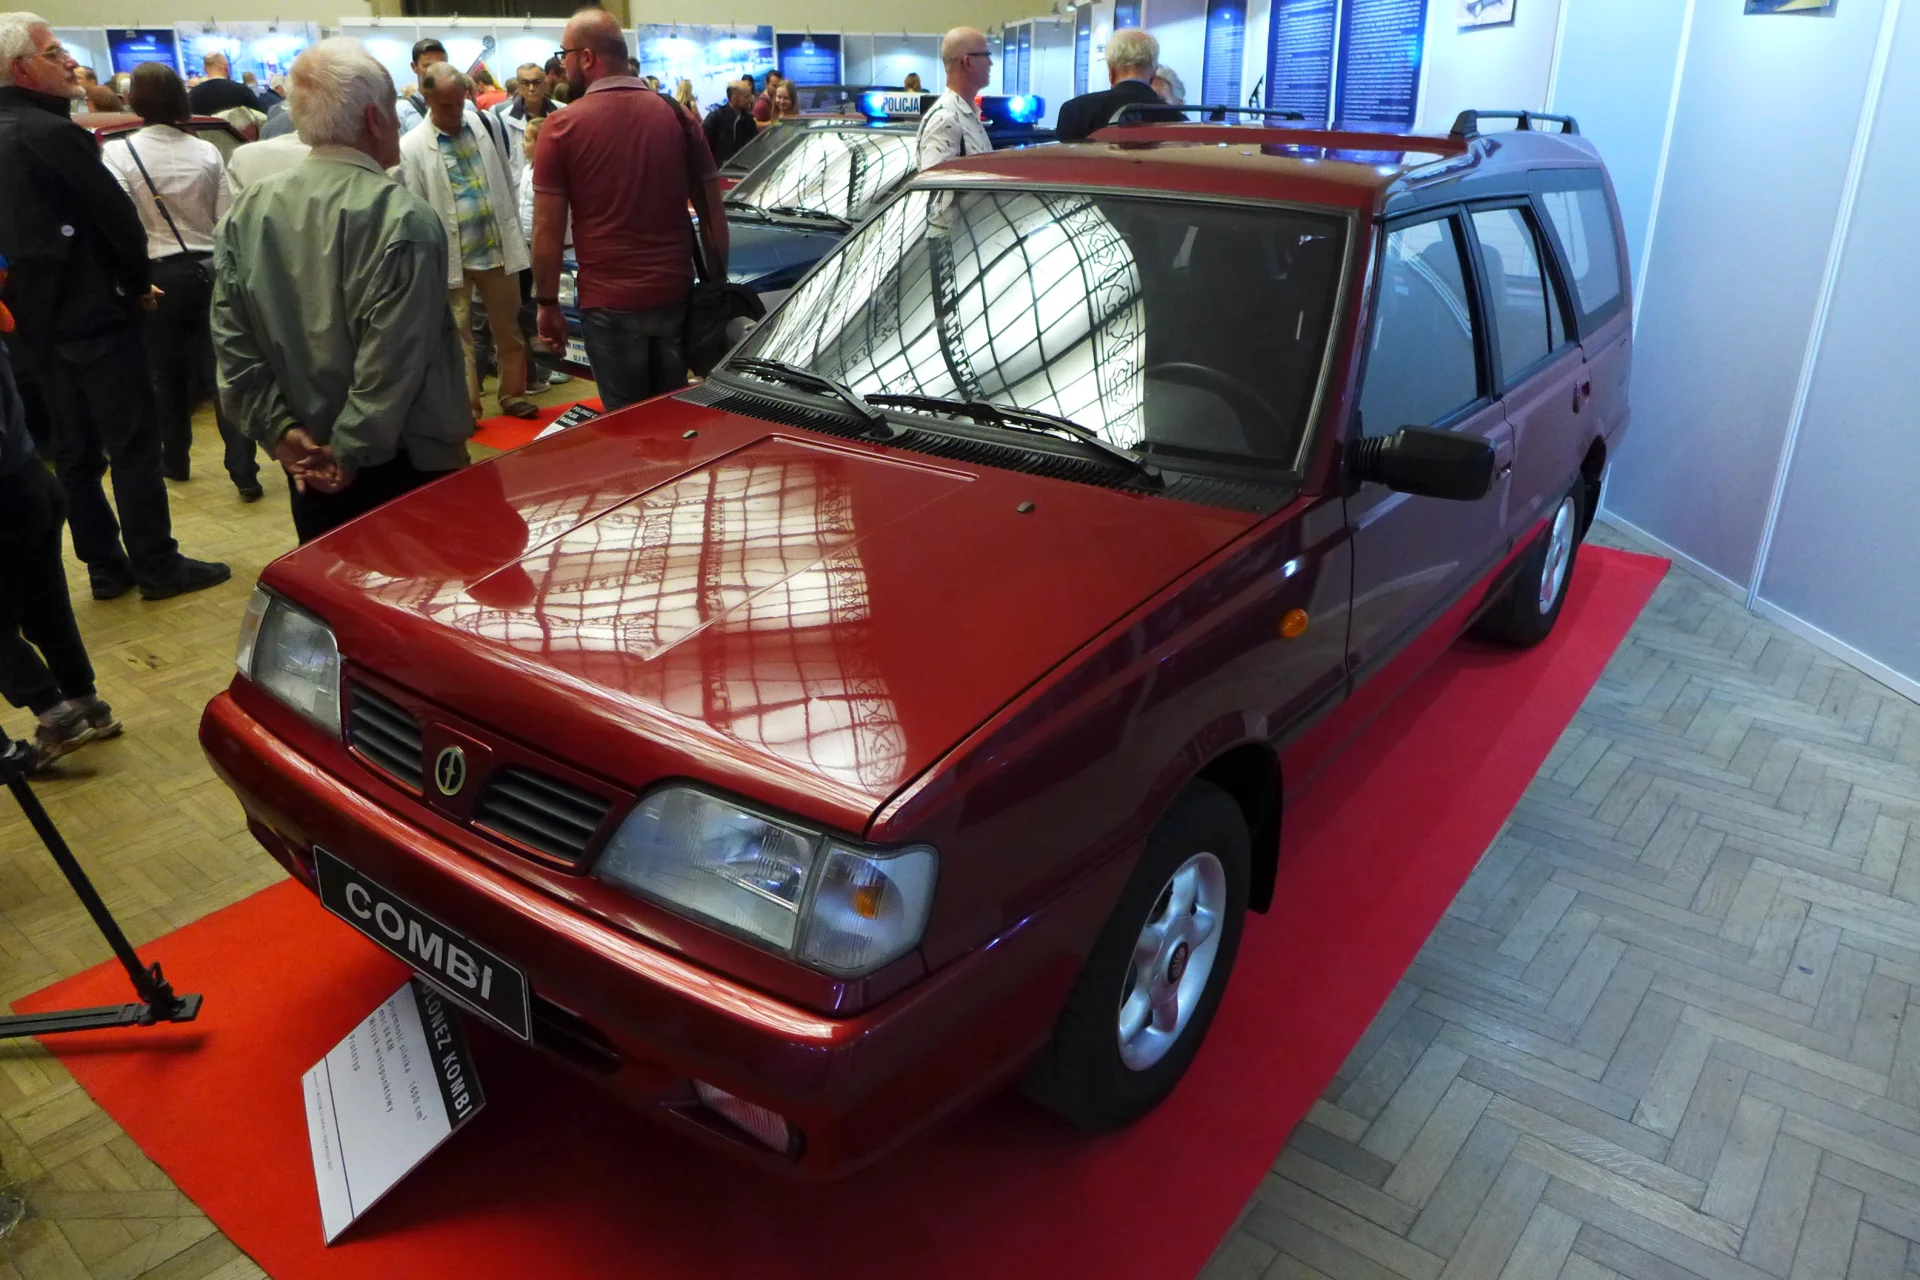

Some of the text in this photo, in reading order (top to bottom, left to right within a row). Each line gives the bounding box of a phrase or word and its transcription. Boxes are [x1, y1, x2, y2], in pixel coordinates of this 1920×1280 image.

[881, 97, 919, 112] POLICJA
[345, 882, 493, 1000] COMBI
[349, 1033, 360, 1072] Prototyp
[378, 1008, 387, 1026] moc
[385, 1039, 395, 1052] KM
[421, 984, 473, 1119] OLONEZ KOMBI
[368, 1016, 394, 1113] Wtrysk wielopunktowy
[399, 1044, 411, 1074] silnika
[408, 1080, 420, 1104] 1600
